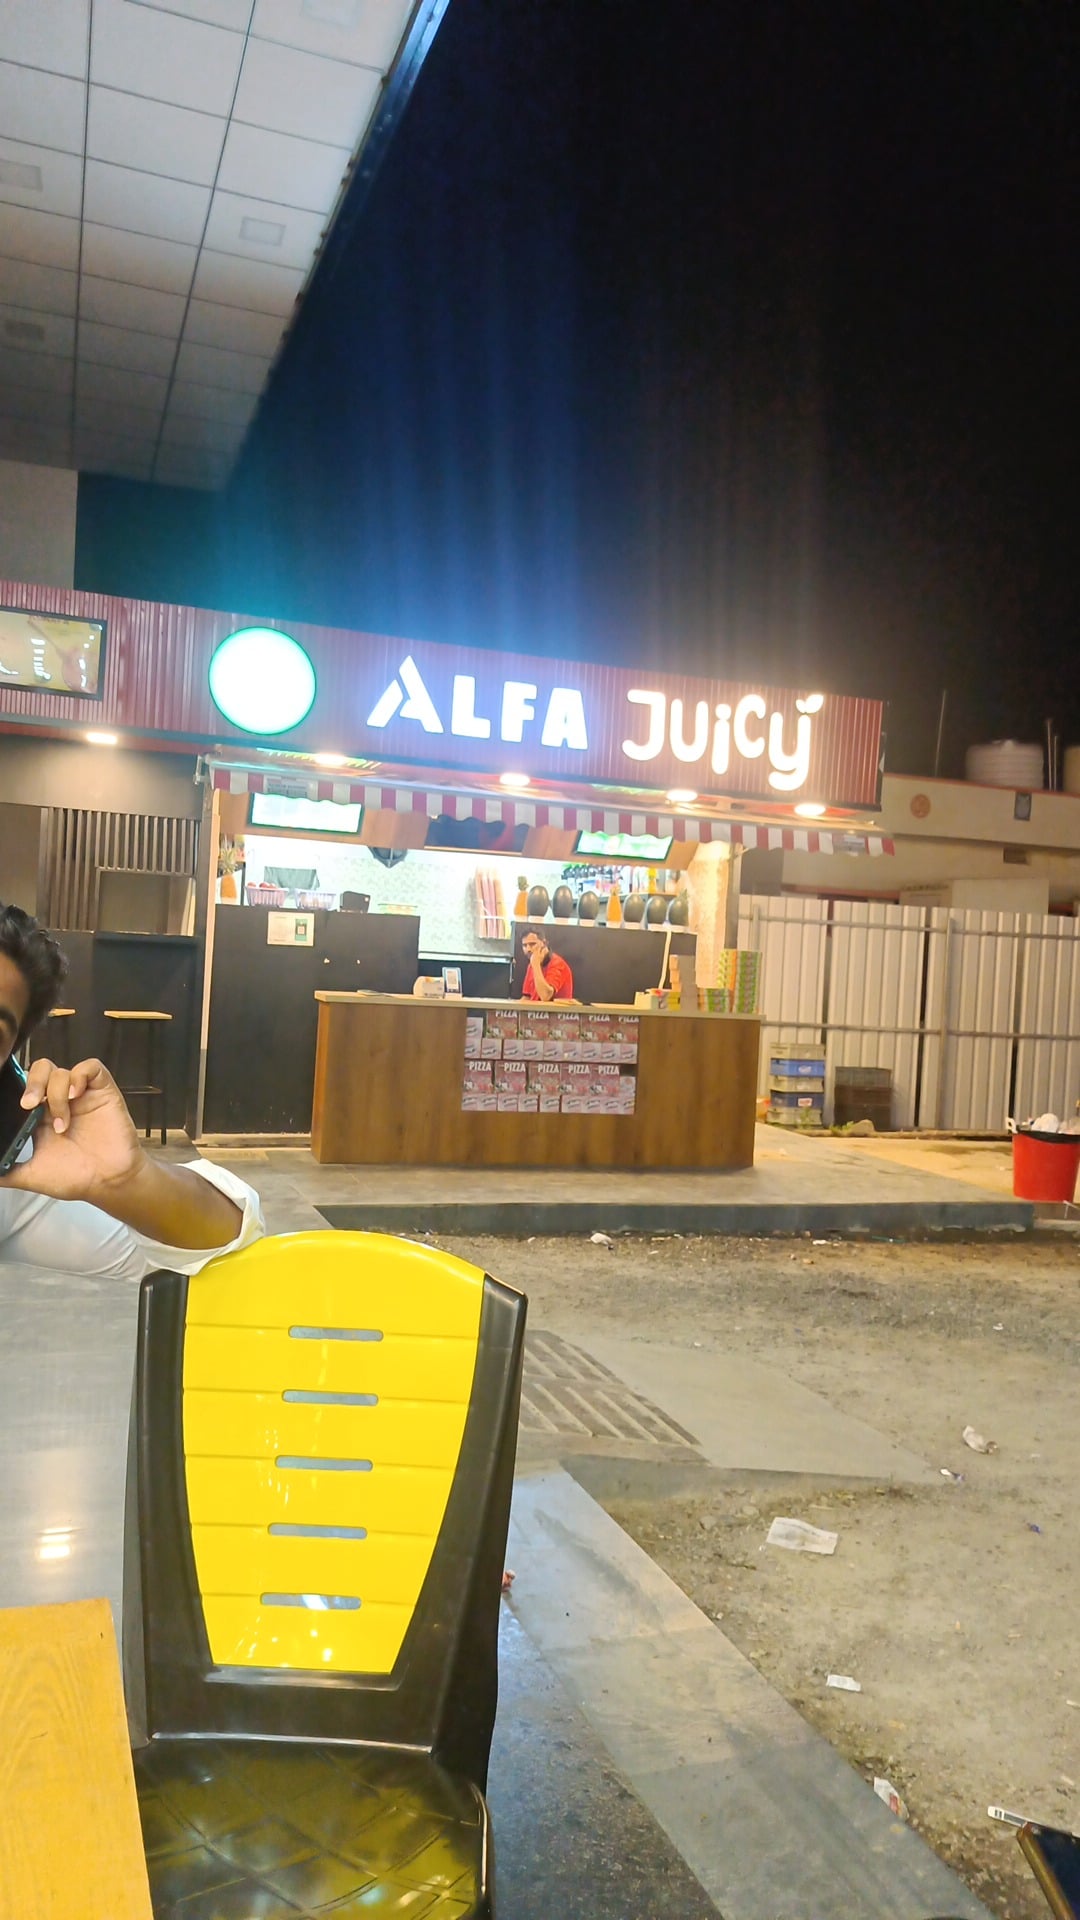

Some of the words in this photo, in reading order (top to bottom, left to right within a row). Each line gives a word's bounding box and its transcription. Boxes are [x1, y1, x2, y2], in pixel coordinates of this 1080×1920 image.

[366, 655, 589, 750] ALFA
[495, 1009, 518, 1018] PIZZA
[469, 1061, 492, 1072] PIZZA
[504, 1062, 526, 1072] PIZZA
[538, 1063, 560, 1073] PIZZA
[568, 1064, 591, 1075] PIZZA
[598, 1065, 620, 1075] PIZZA
